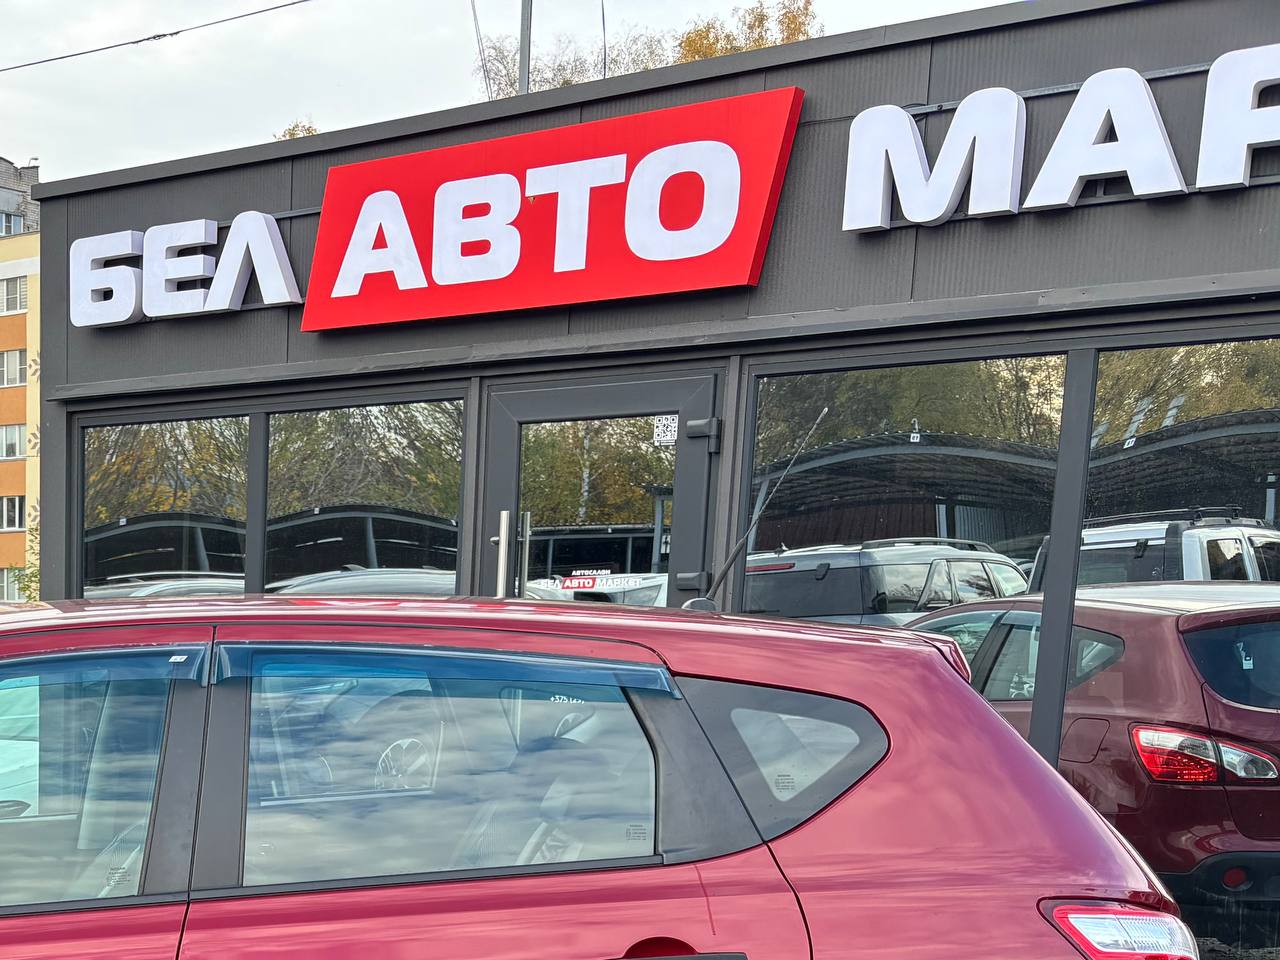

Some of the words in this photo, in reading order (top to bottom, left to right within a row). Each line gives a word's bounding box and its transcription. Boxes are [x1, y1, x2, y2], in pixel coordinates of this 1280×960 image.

[70, 210, 303, 328] БЕЛ
[330, 140, 741, 298] АВТО
[564, 578, 593, 588] АВТО
